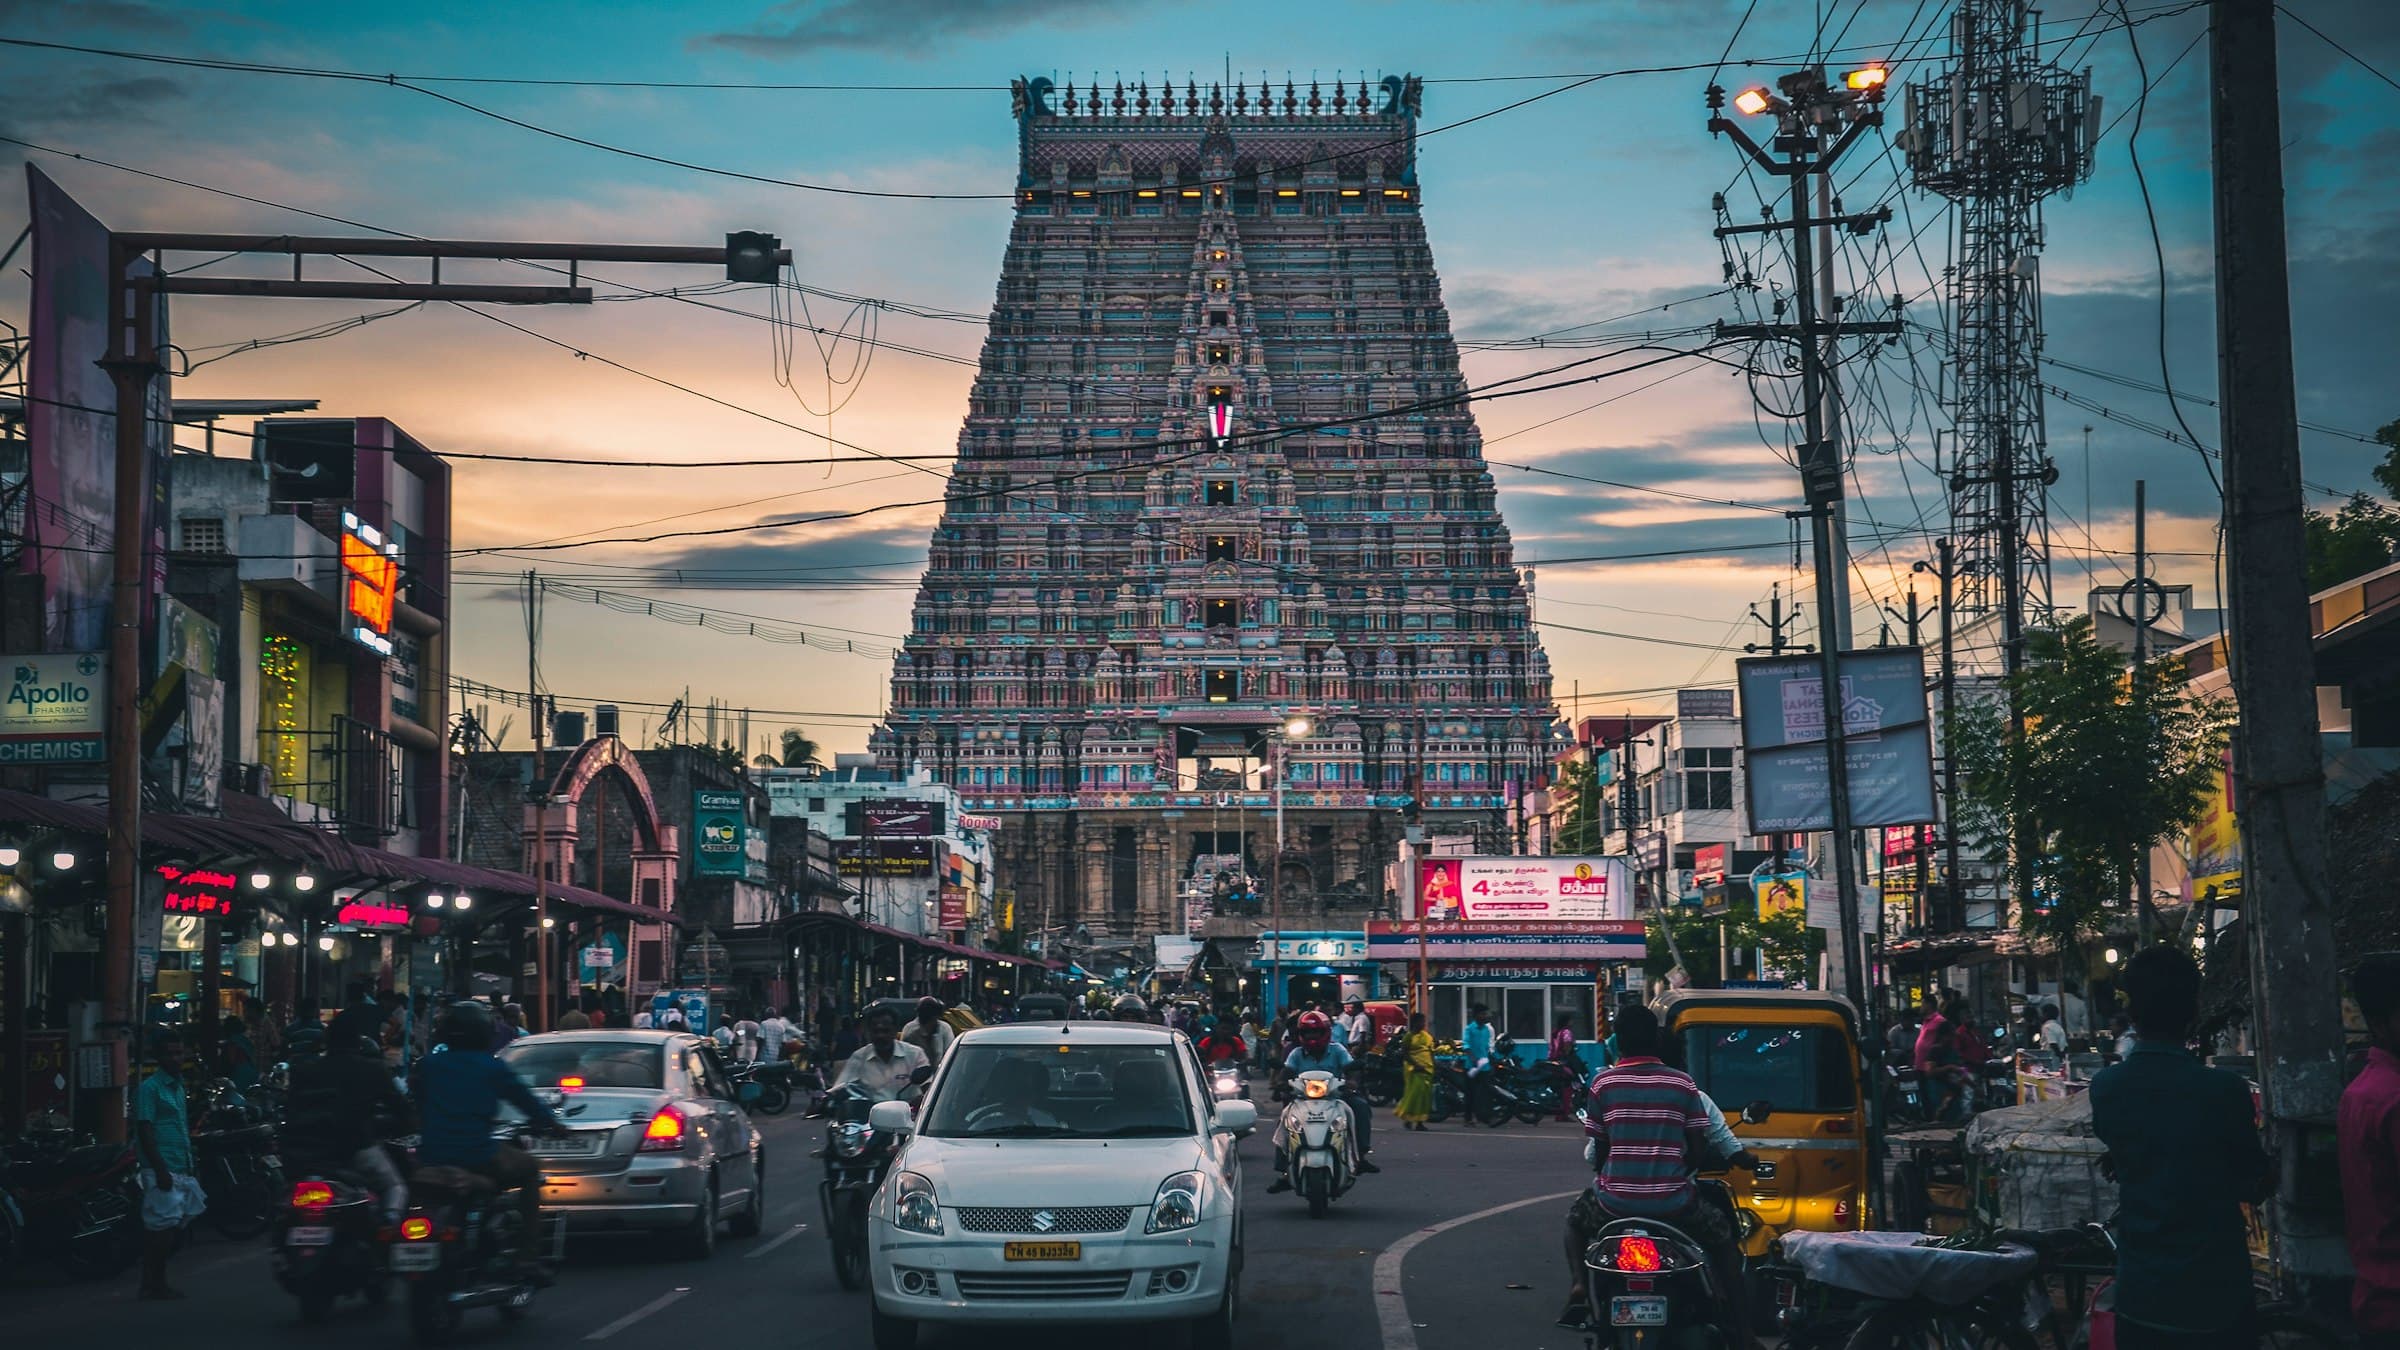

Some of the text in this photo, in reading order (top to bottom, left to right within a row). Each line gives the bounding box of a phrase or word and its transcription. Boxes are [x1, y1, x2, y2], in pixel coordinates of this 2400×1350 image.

[7, 682, 89, 714] Apollo
[0, 742, 97, 760] CHEMIST
[959, 815, 999, 829] ROOMS
[1490, 966, 1538, 979] மாநகர
[1542, 964, 1586, 977] காவல்
